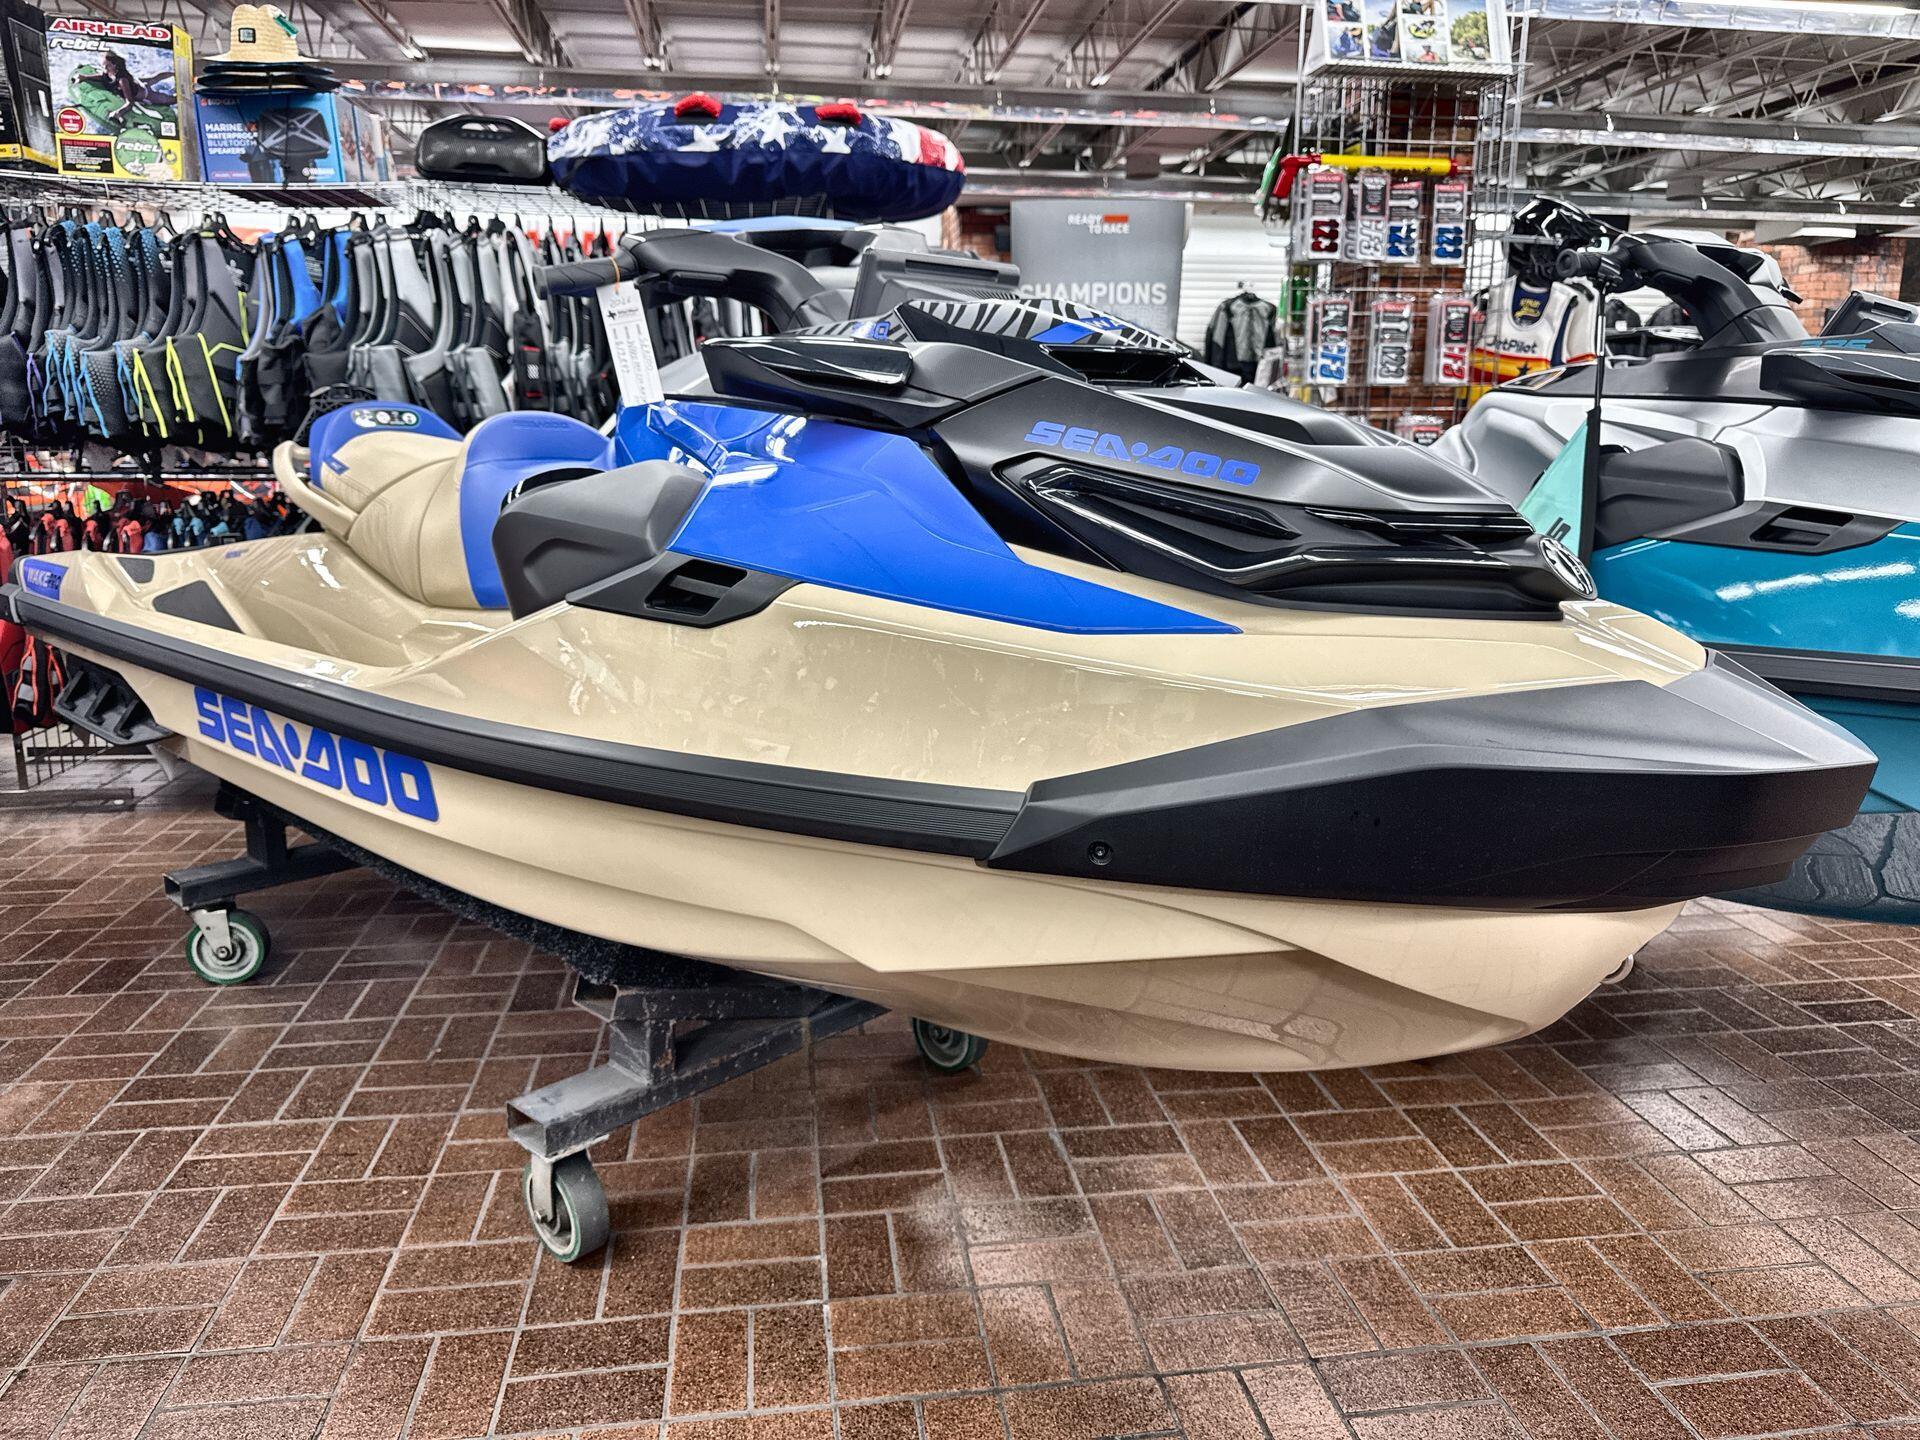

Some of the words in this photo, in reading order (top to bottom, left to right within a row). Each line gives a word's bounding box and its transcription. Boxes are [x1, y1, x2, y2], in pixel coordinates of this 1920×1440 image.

[50, 18, 171, 41] AIRHEAD
[205, 123, 243, 132] MARINE
[207, 139, 257, 147] BLUETOOTH
[208, 147, 246, 155] SPEAKERS
[1067, 214, 1102, 225] READY
[1088, 224, 1102, 234] TO
[1103, 223, 1130, 234] RACE
